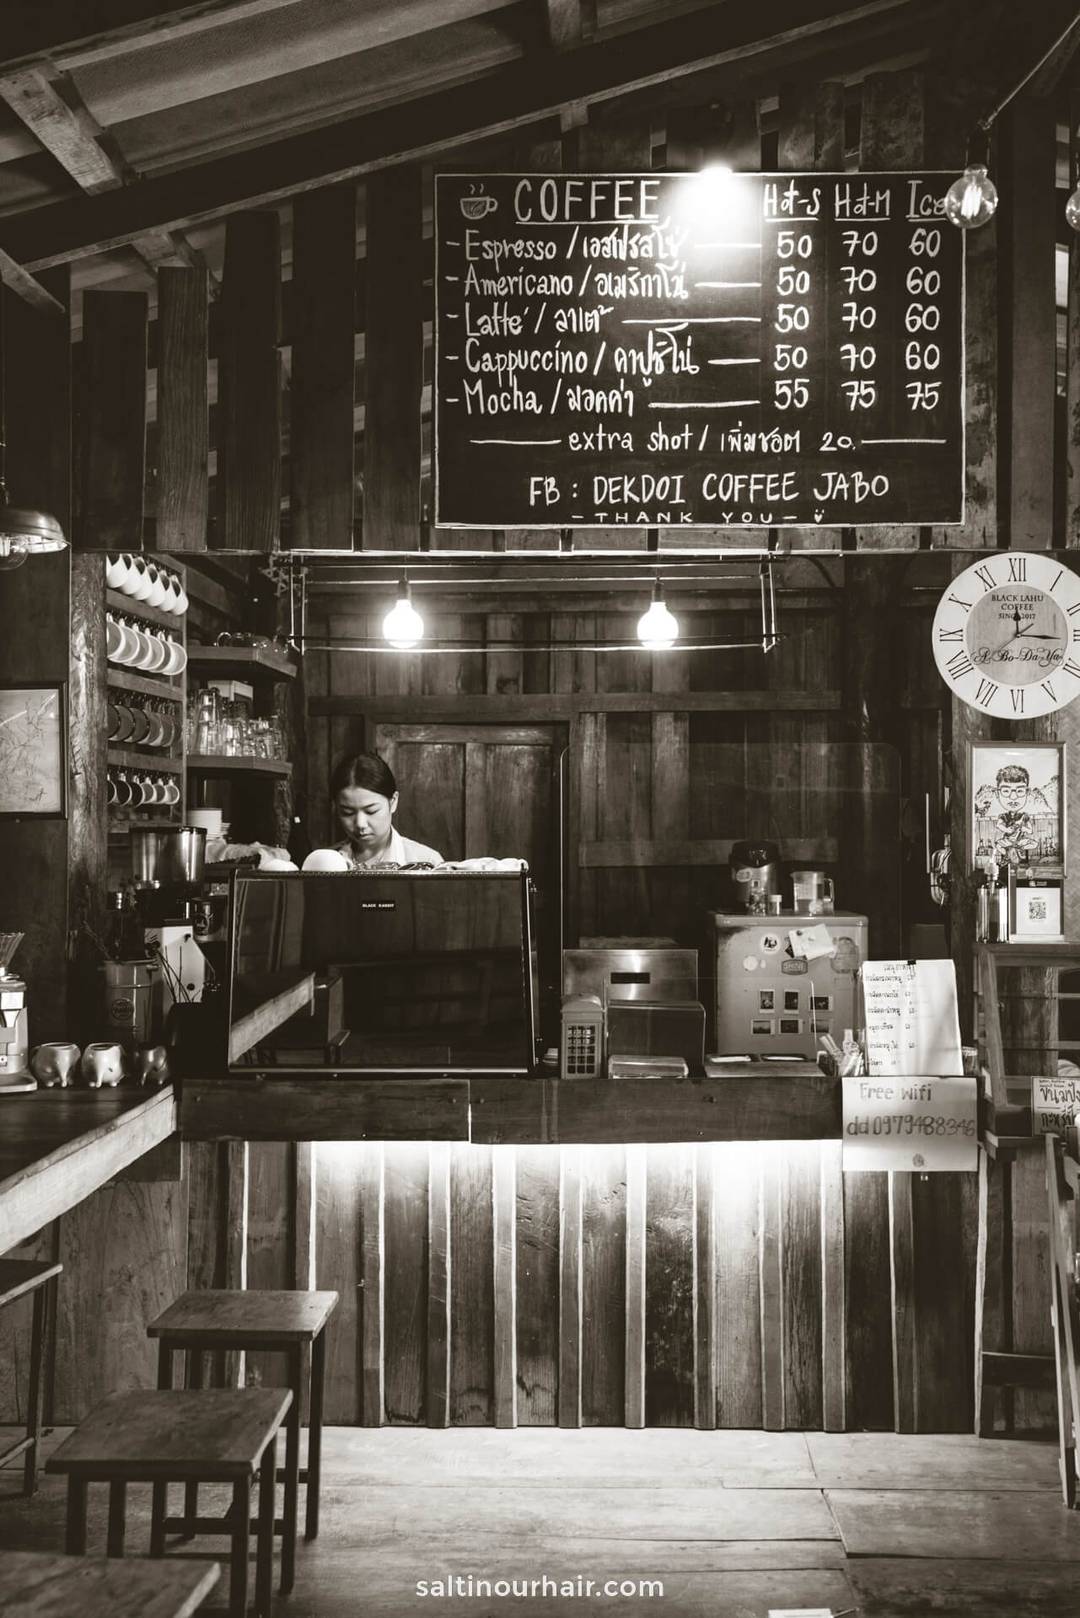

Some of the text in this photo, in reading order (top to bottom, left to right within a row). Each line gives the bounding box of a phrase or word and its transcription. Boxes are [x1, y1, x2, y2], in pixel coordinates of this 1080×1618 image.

[514, 178, 661, 221] COFFEE
[905, 180, 946, 218] Ice
[466, 229, 557, 272] Espresso
[777, 230, 812, 258] 50
[842, 230, 878, 257] 70
[908, 228, 941, 257] 60
[464, 264, 573, 297] Americano
[776, 266, 810, 296] 50
[840, 266, 877, 294] 70
[906, 266, 941, 295] 60
[774, 303, 810, 333] 50
[842, 302, 876, 332] 70
[905, 303, 940, 332] 60
[465, 338, 588, 387] Cappuccino
[774, 344, 808, 371] 50
[840, 343, 876, 372] 70
[905, 341, 940, 370] 60
[463, 375, 543, 414] Mocha
[774, 378, 810, 410] 55
[841, 380, 876, 411] 75
[905, 381, 942, 410] 75
[569, 423, 634, 452] extra
[647, 421, 693, 451] shot
[530, 476, 560, 506] FB
[593, 474, 686, 505] DEKDOI
[702, 471, 800, 503] COFFEE
[813, 471, 889, 503] JABO
[594, 511, 773, 524] THANK YOU
[1008, 557, 1027, 582] XII
[992, 594, 1044, 602] BLACK LAHU
[1001, 603, 1034, 611] COFFEE
[860, 1082, 894, 1100] Free
